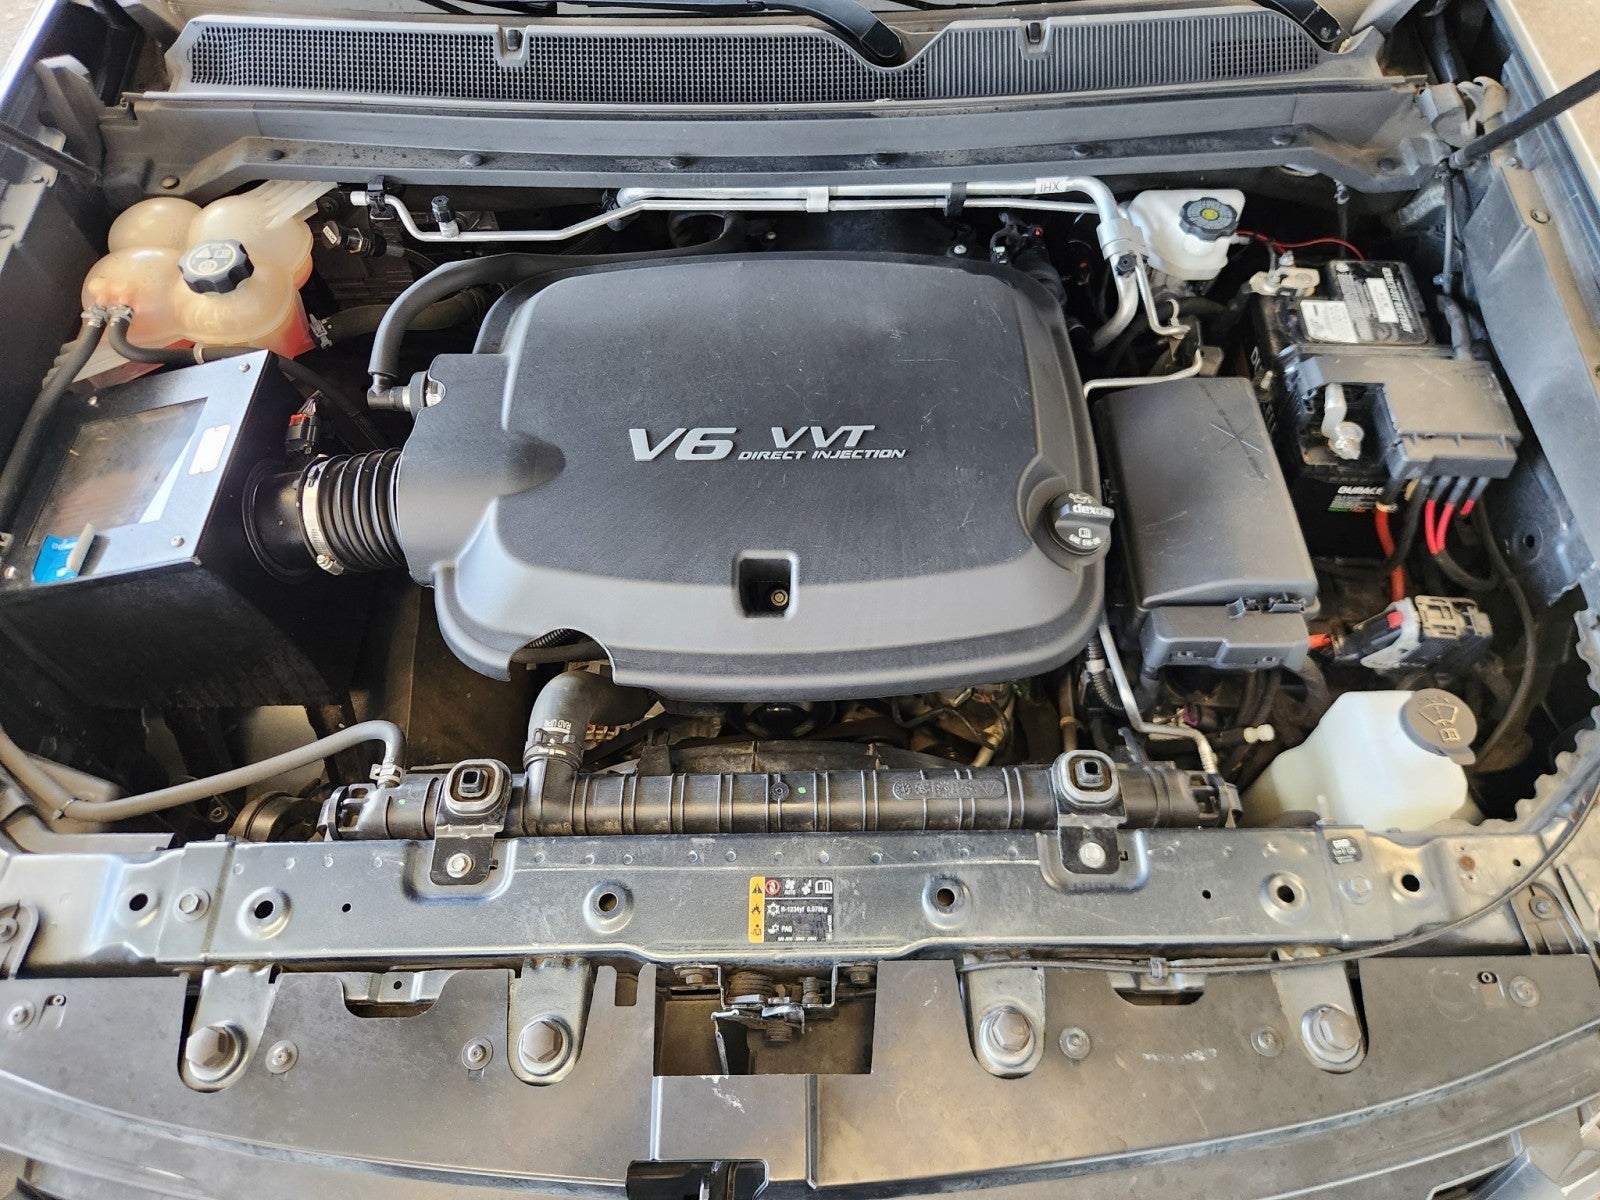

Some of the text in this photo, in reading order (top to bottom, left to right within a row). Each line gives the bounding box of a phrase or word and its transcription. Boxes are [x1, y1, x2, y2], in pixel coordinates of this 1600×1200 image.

[1039, 180, 1061, 193] IHX
[770, 424, 877, 449] VVT
[628, 426, 738, 462] V6
[737, 448, 908, 461] DIRECT INJECTION
[1337, 485, 1385, 495] DURACE
[1072, 503, 1112, 518] dexos
[557, 719, 572, 730] RAD
[781, 925, 793, 933] PAG
